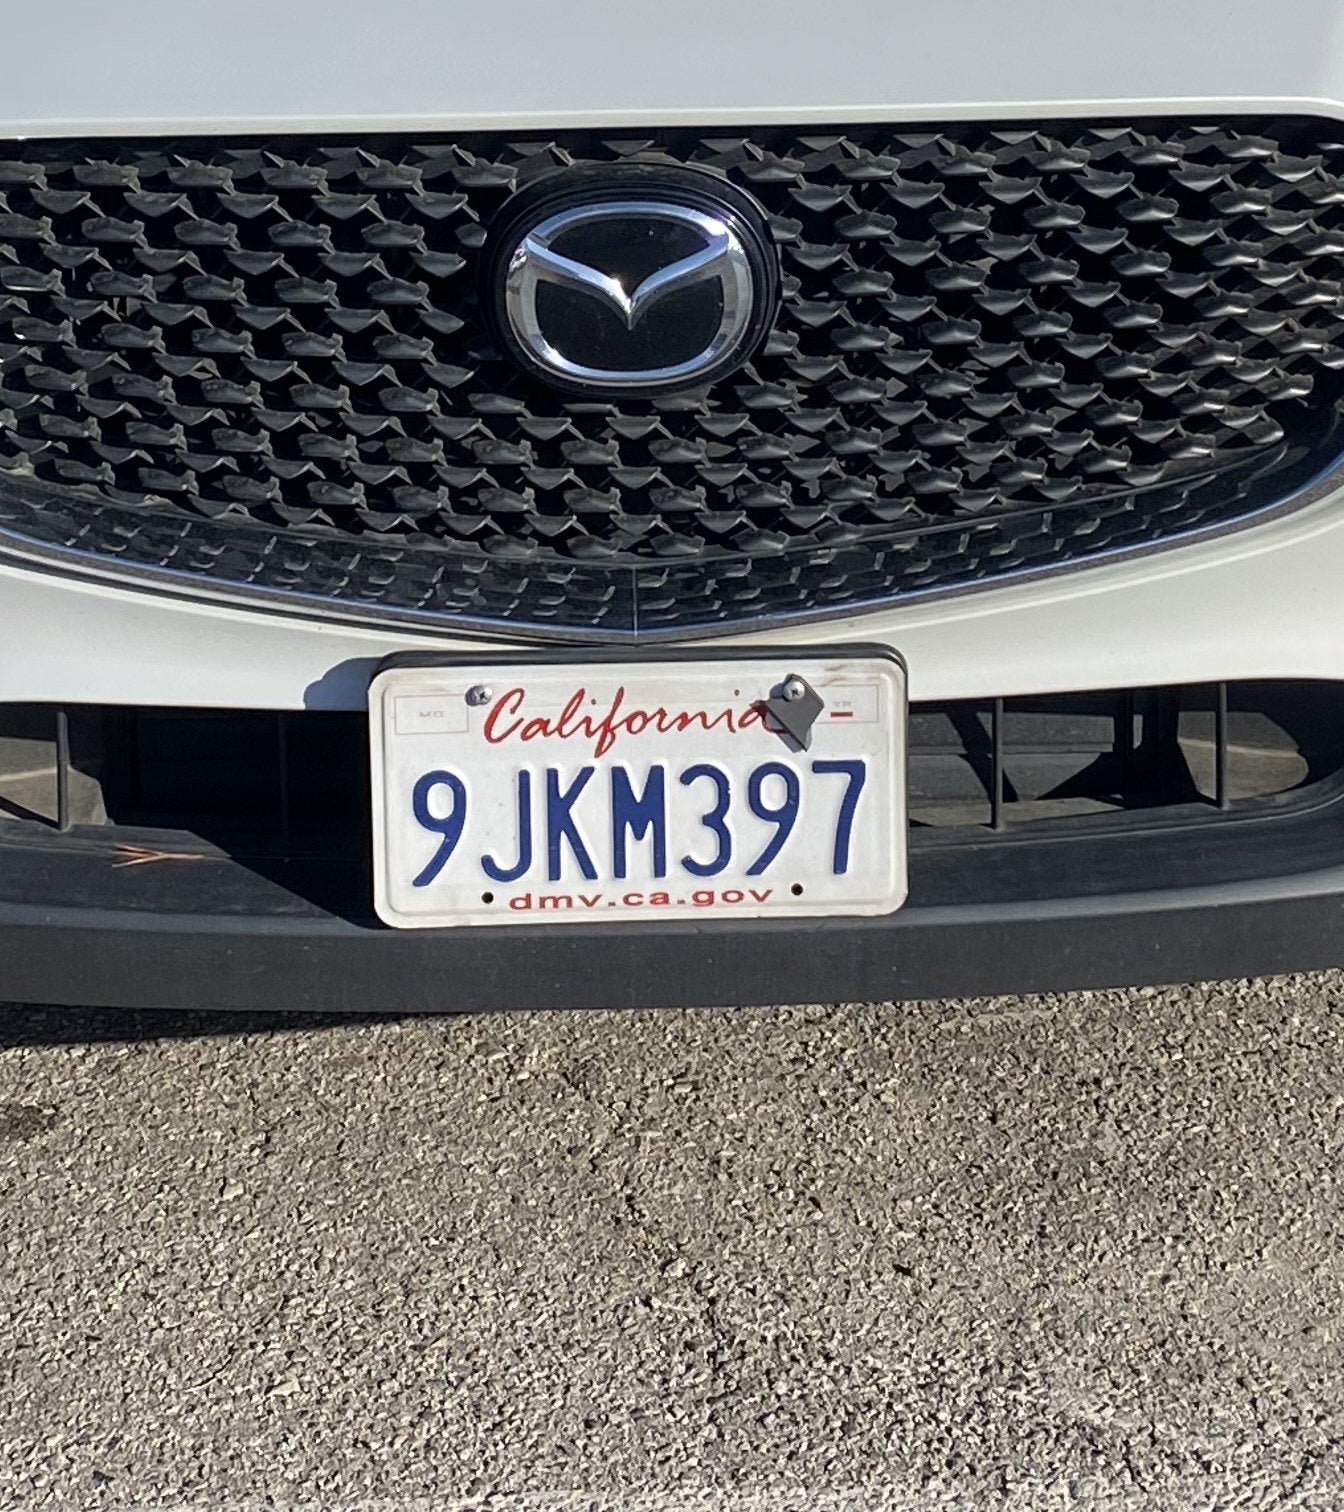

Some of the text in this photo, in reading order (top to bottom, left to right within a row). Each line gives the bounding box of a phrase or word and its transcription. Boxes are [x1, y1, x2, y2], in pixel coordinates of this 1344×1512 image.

[483, 686, 786, 759] California
[412, 759, 867, 887] 9JKM397
[509, 887, 774, 911] dmv.ca.gov
